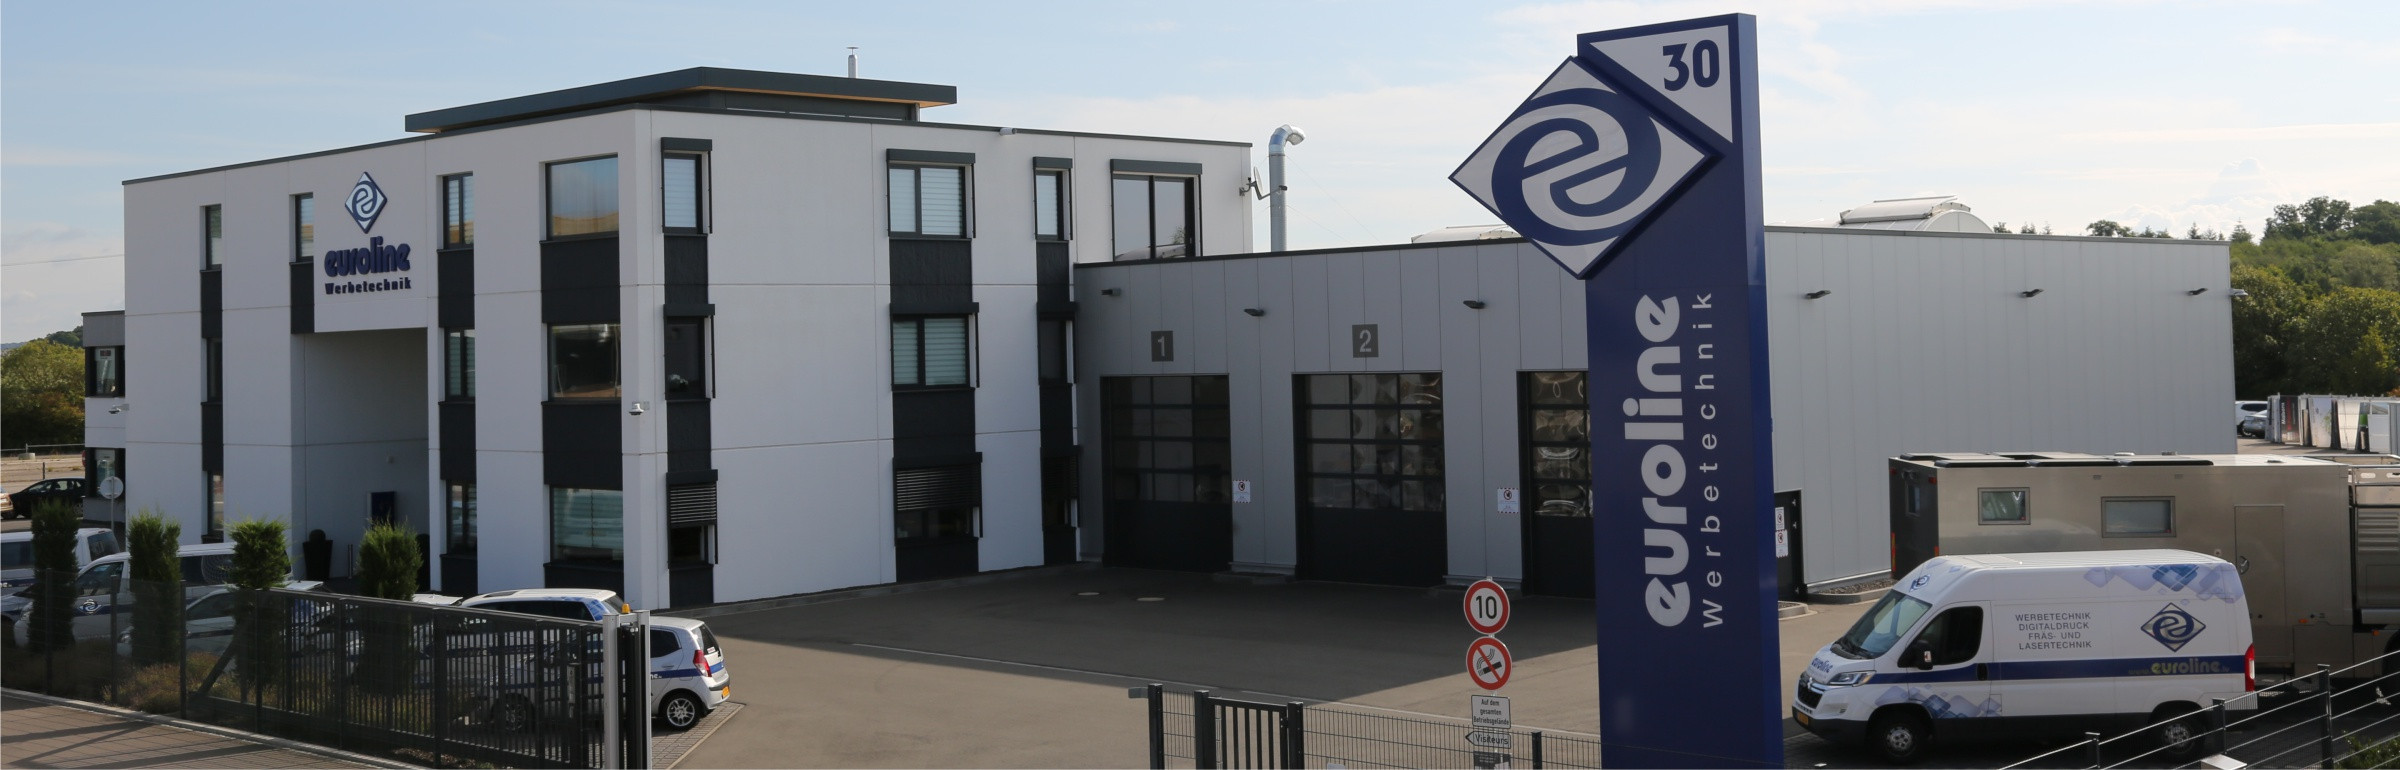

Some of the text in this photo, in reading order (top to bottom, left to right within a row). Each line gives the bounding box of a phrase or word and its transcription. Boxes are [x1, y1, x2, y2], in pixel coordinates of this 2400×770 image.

[1662, 39, 1720, 91] 30
[324, 235, 411, 277] euroline
[325, 277, 411, 295] Werbetechnik
[1157, 336, 1166, 357] 1
[1359, 329, 1372, 353] 2
[1622, 294, 1691, 627] euroline
[1692, 293, 1724, 628] Werbetechnik
[1475, 595, 1498, 619] 10
[2015, 612, 2091, 622] WERBETECHNIK
[2019, 621, 2089, 631] DIGITALDRUCK
[2028, 631, 2081, 640] FRÄS- UND
[2019, 641, 2092, 650] LASERTECHNIK
[1481, 698, 1489, 706] Auf
[1475, 733, 1509, 745] Visiteurs
